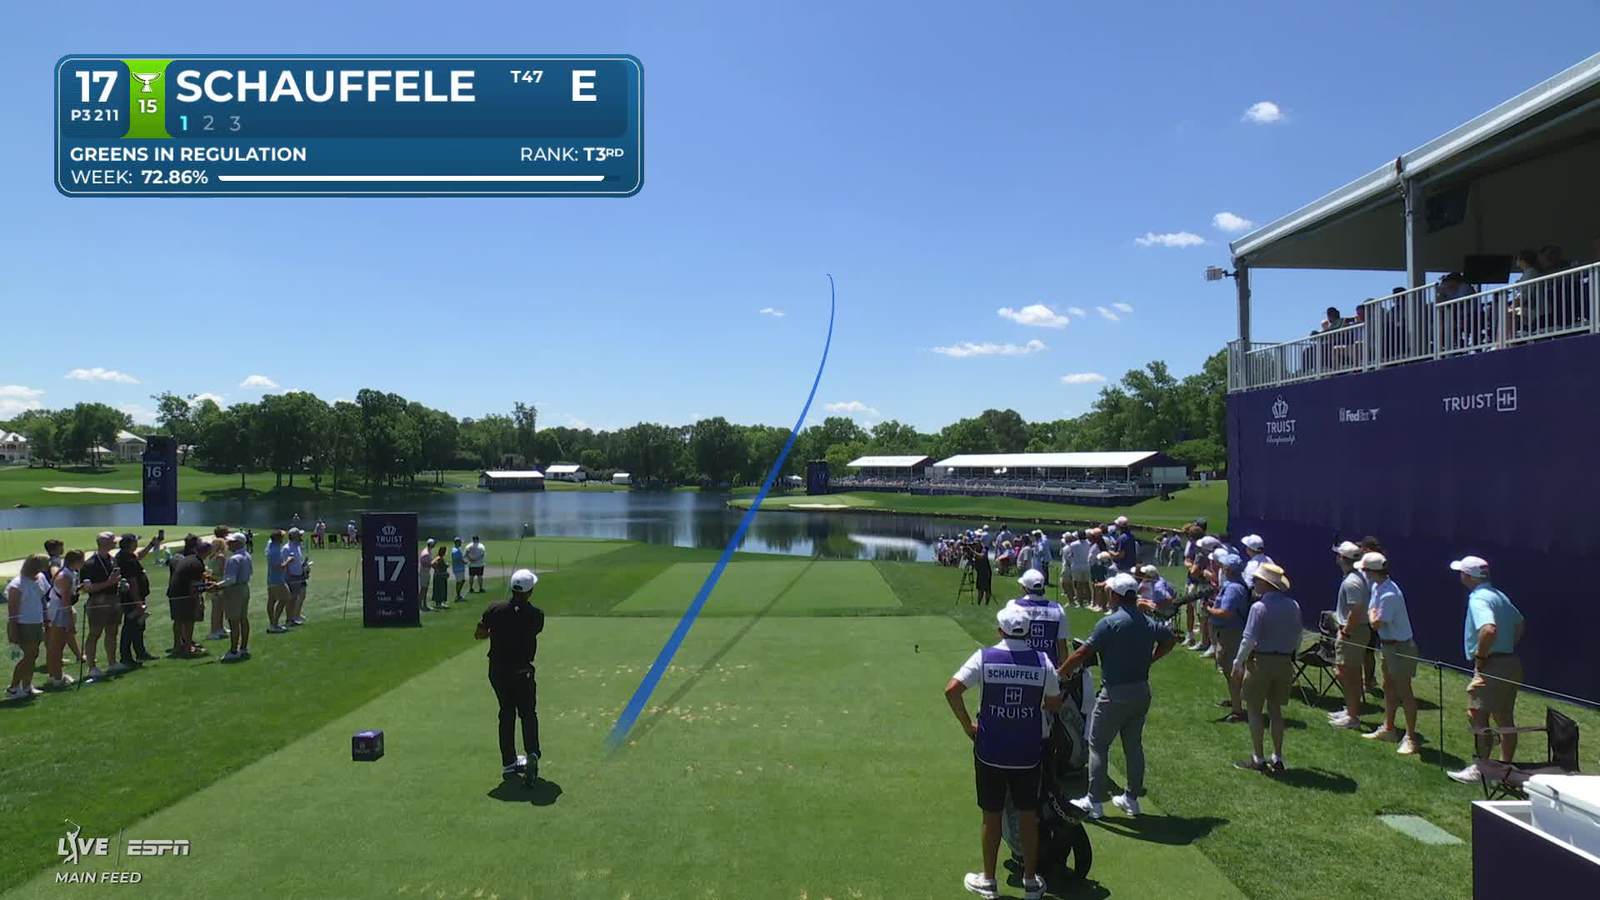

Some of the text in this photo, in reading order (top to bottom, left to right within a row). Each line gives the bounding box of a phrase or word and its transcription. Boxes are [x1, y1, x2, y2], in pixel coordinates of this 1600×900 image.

[1442, 392, 1494, 413] TRUIST
[1265, 419, 1297, 435] TRUIST
[146, 466, 162, 478] 16
[375, 535, 403, 544] TRUIST
[374, 555, 406, 582] 17
[1025, 638, 1055, 649] RUIST
[987, 667, 1040, 682] SCHAUFFELE
[988, 704, 1035, 720] TRUIST
